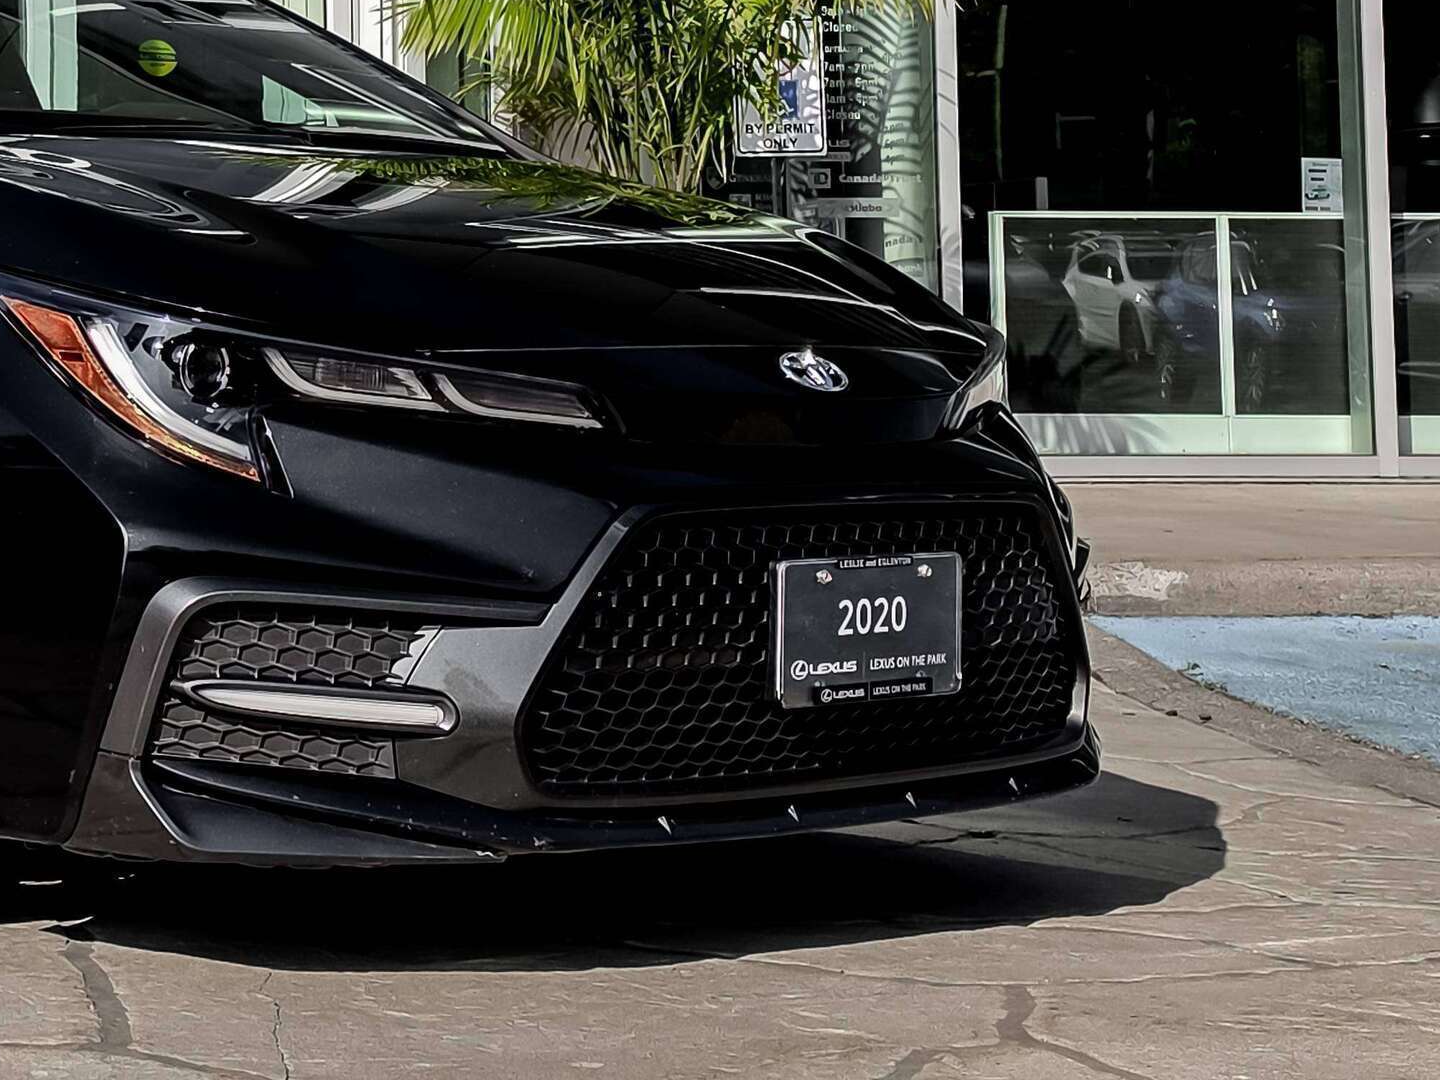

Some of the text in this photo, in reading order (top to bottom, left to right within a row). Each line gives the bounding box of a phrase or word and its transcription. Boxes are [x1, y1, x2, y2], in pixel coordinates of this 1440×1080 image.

[745, 123, 815, 134] BY PERMIT
[763, 137, 798, 149] ONLY
[865, 558, 877, 567] and
[837, 595, 908, 637] 2020
[809, 652, 947, 675] LEXUS LEXUS ON THE PARK
[833, 687, 865, 699] LEXUS
[872, 685, 891, 696] LEXUS
